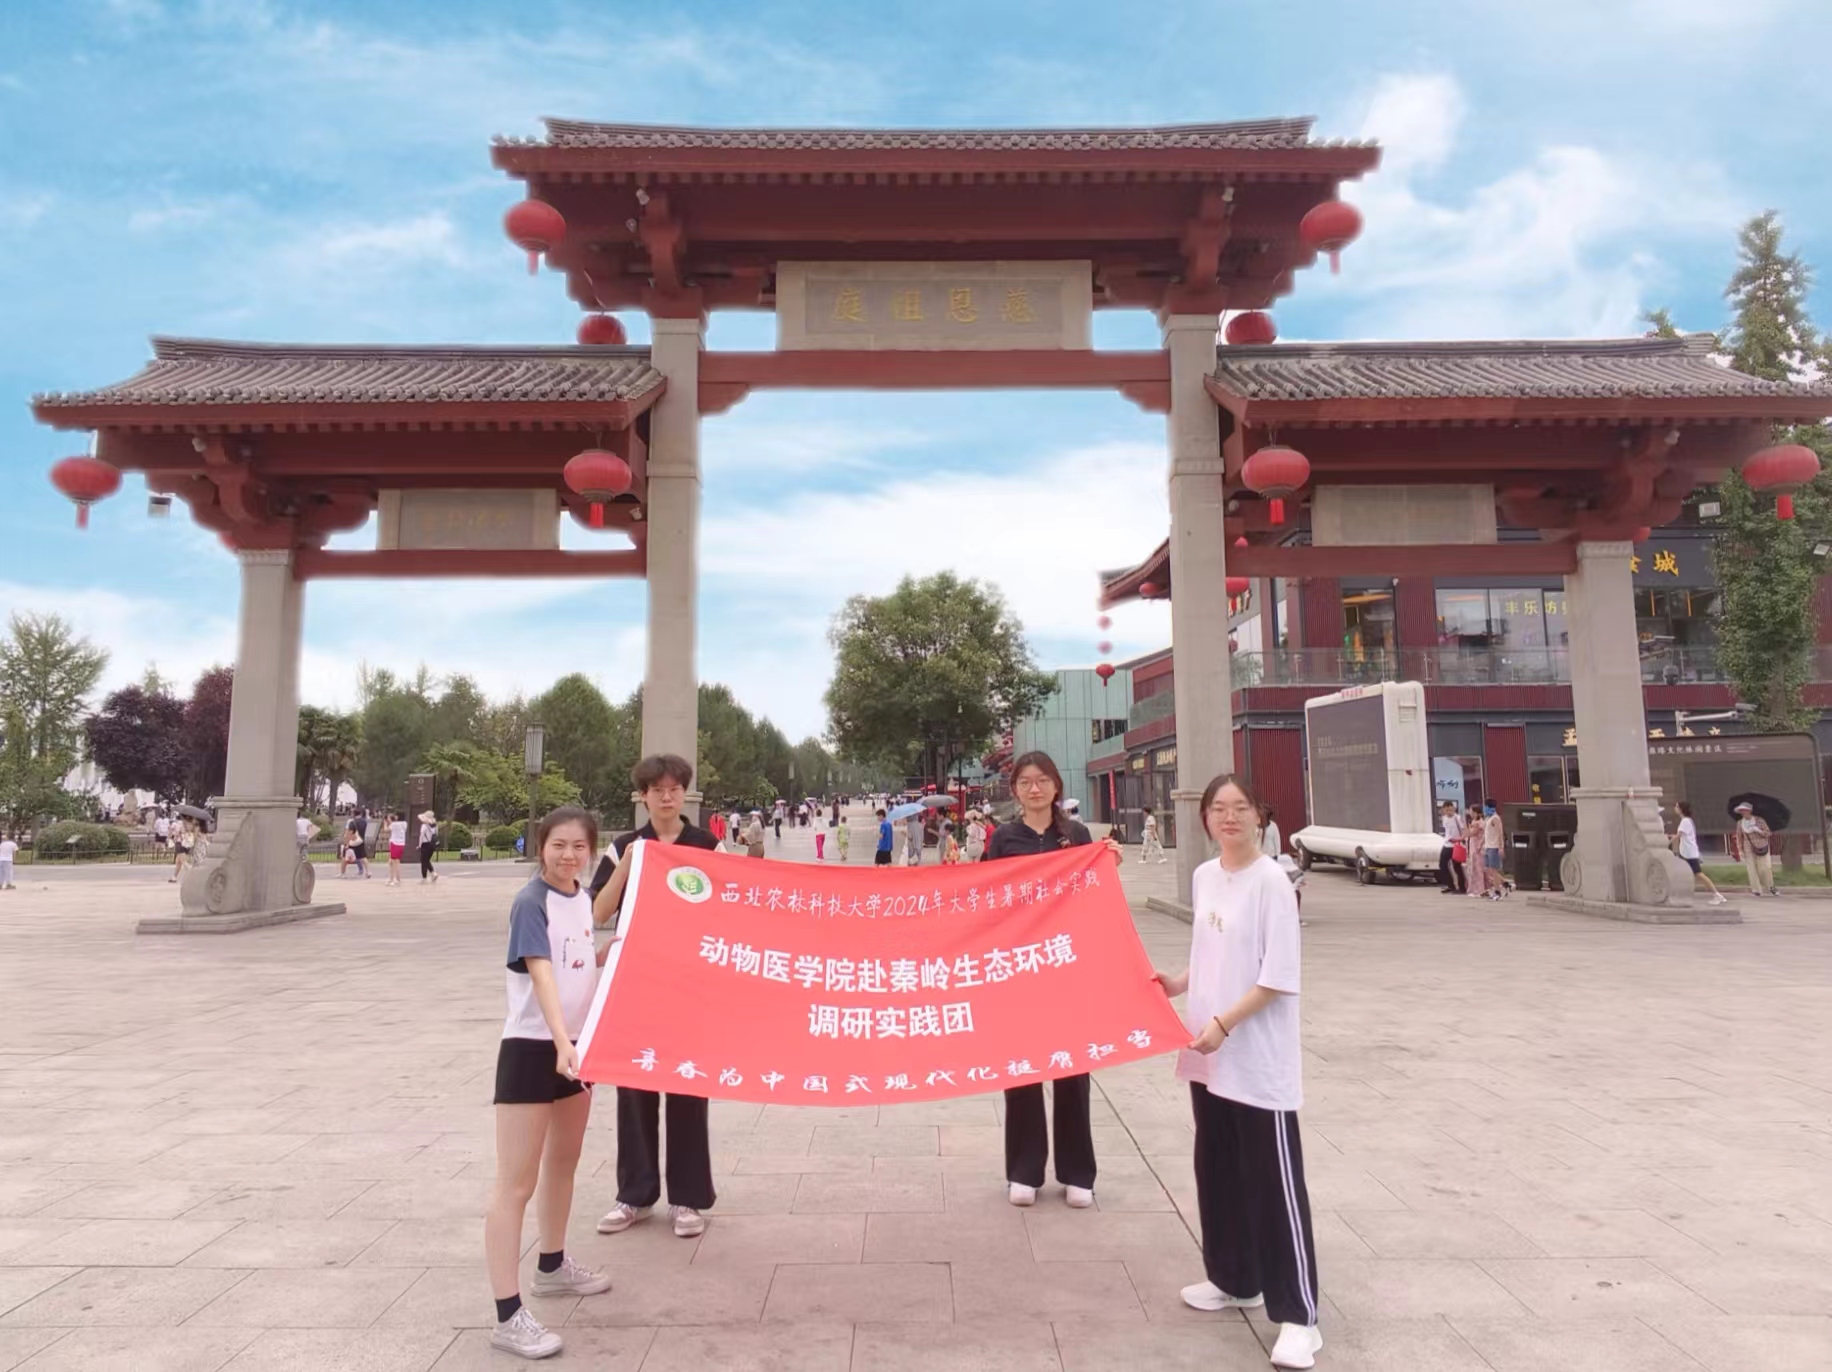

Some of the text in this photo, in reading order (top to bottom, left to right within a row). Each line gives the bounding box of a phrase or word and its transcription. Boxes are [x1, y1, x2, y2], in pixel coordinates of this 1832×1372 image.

[720, 867, 1101, 919] 西北农林科技大学2024年大学生暑期社会实践
[699, 933, 1078, 993] 动物医学院赴秦岭生态环境
[807, 1001, 975, 1039] 调研实践团
[631, 1028, 1152, 1093] 青春为中国式现代化挺膺担当
